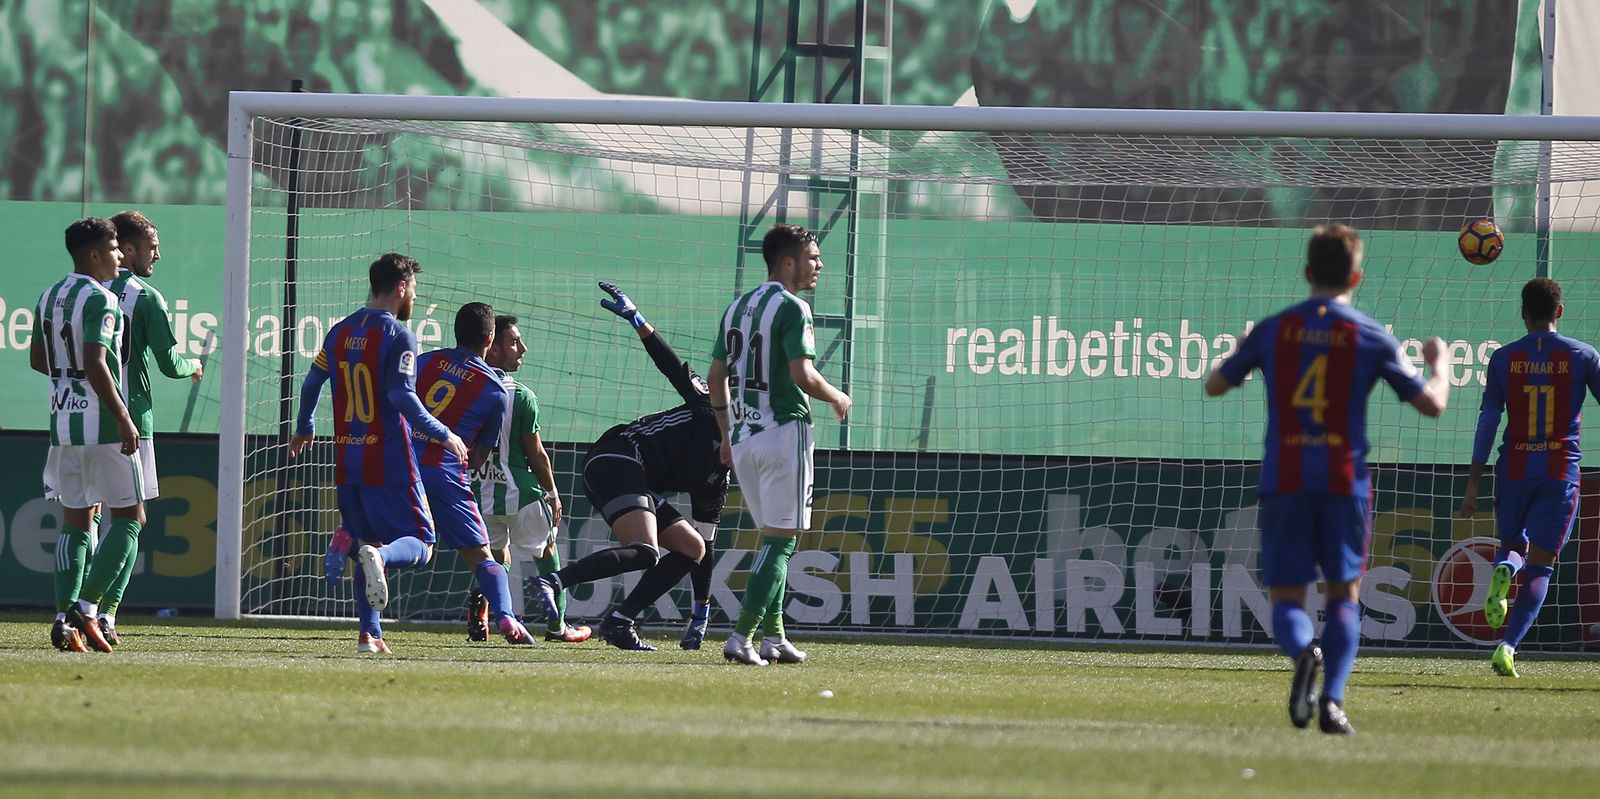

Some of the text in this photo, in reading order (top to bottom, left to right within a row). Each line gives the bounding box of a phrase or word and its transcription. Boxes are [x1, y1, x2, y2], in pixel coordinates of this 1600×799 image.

[43, 318, 87, 381] 11
[344, 336, 368, 350] MESSI
[726, 327, 769, 393] 21
[1292, 354, 1329, 423] 4
[1510, 361, 1569, 374] NEYMAR JR
[51, 387, 89, 411] Wiko
[339, 361, 375, 424] 10
[425, 379, 456, 417] 9
[1523, 385, 1555, 439] 11
[336, 433, 367, 446] unicef
[1515, 438, 1548, 452] unicef
[496, 541, 915, 626] TUKSH
